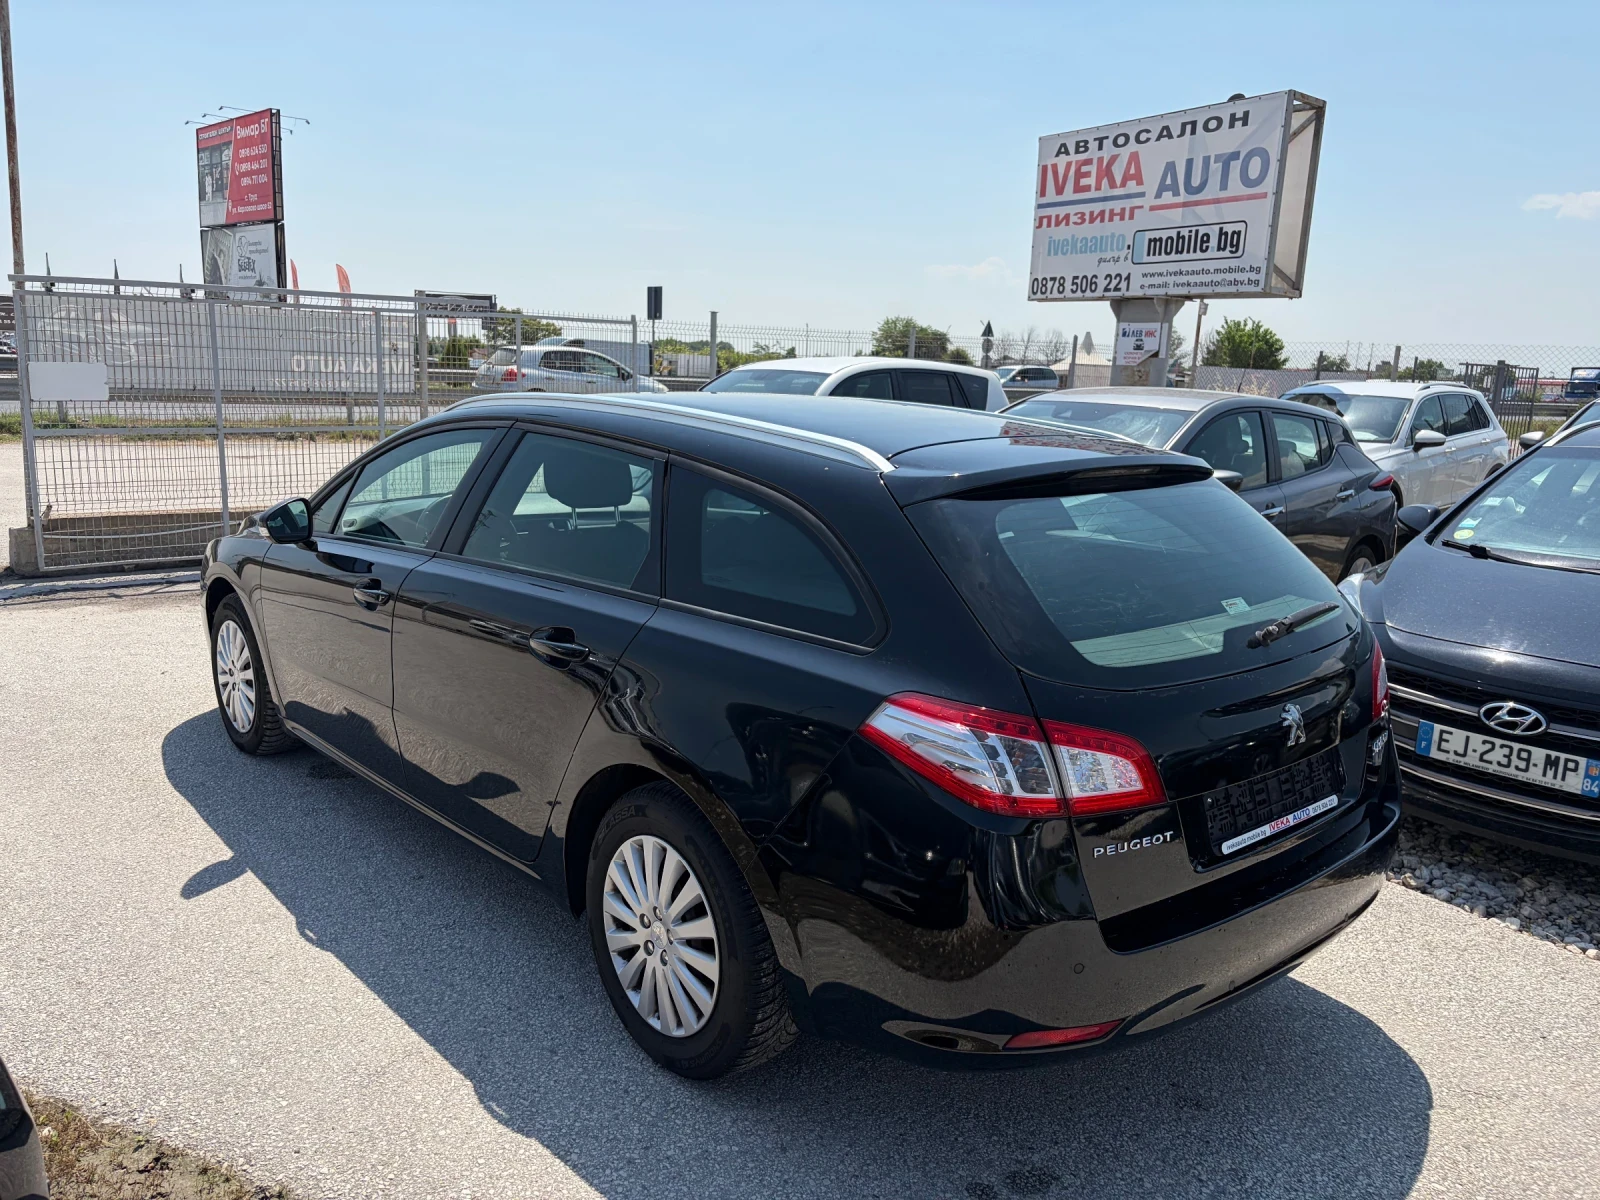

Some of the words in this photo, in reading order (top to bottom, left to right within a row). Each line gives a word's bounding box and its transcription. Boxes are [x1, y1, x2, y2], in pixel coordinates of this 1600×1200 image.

[260, 118, 268, 134] БГ
[1054, 110, 1250, 158] АВТОСАЛОН
[1039, 150, 1145, 198] IVEKA
[1154, 146, 1271, 200] AUTO
[1036, 205, 1144, 230] ЛИЗИНГ
[1146, 227, 1242, 257] mobile.bg
[1141, 265, 1261, 278] www.ivekaauto.mobile.bg
[1031, 276, 1066, 296] 0878
[1070, 274, 1098, 294] 506
[1103, 272, 1132, 292] 221
[1140, 281, 1170, 290] e-mail:
[1173, 278, 1260, 289] ivekaauto@abv.bg
[1436, 729, 1580, 783] EJ-239-MP
[1583, 778, 1599, 793] 84
[1269, 817, 1290, 832] IVEKA
[1292, 808, 1311, 822] AUTO
[1093, 831, 1174, 858] PEUGEOT
